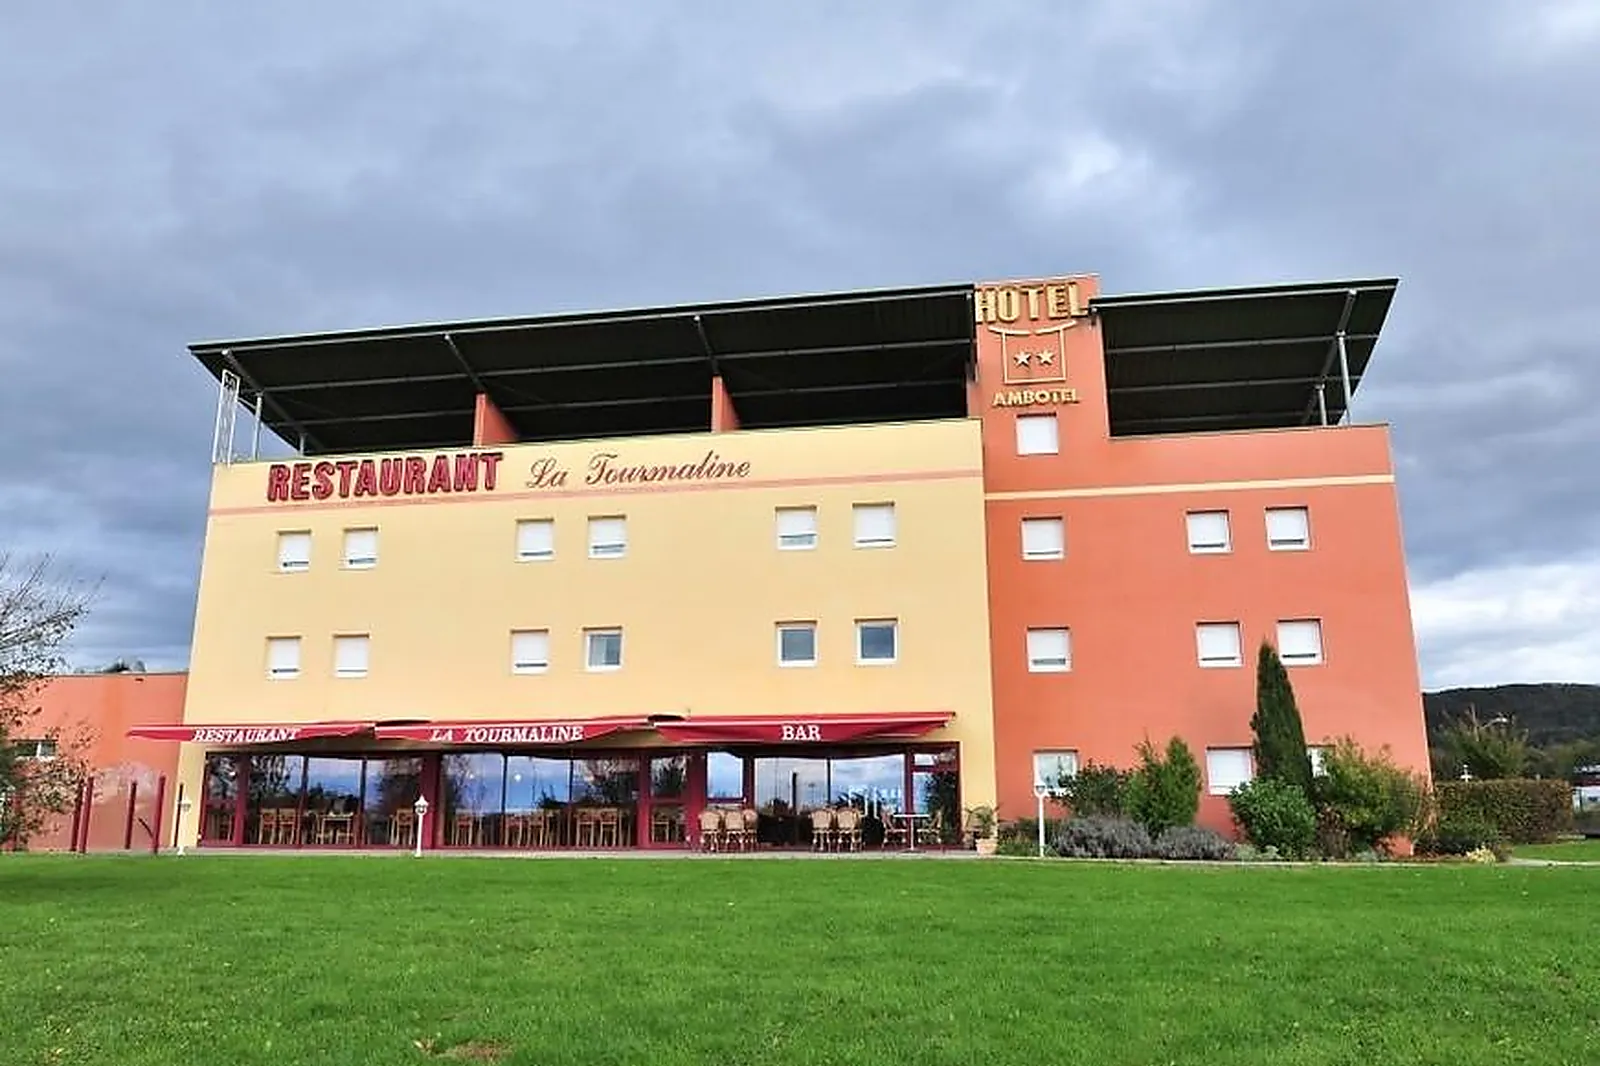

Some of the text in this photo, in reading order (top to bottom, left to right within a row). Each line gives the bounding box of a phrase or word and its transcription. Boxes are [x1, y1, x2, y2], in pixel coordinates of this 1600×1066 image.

[974, 281, 1089, 324] HOTEL
[992, 388, 1079, 408] AMBOTEL
[267, 452, 503, 501] RESTAURANT
[526, 450, 751, 489] La Tourmaline
[193, 727, 300, 743] RESTAURANT
[430, 726, 584, 743] LA TOURMALINE
[781, 724, 821, 741] BAR
